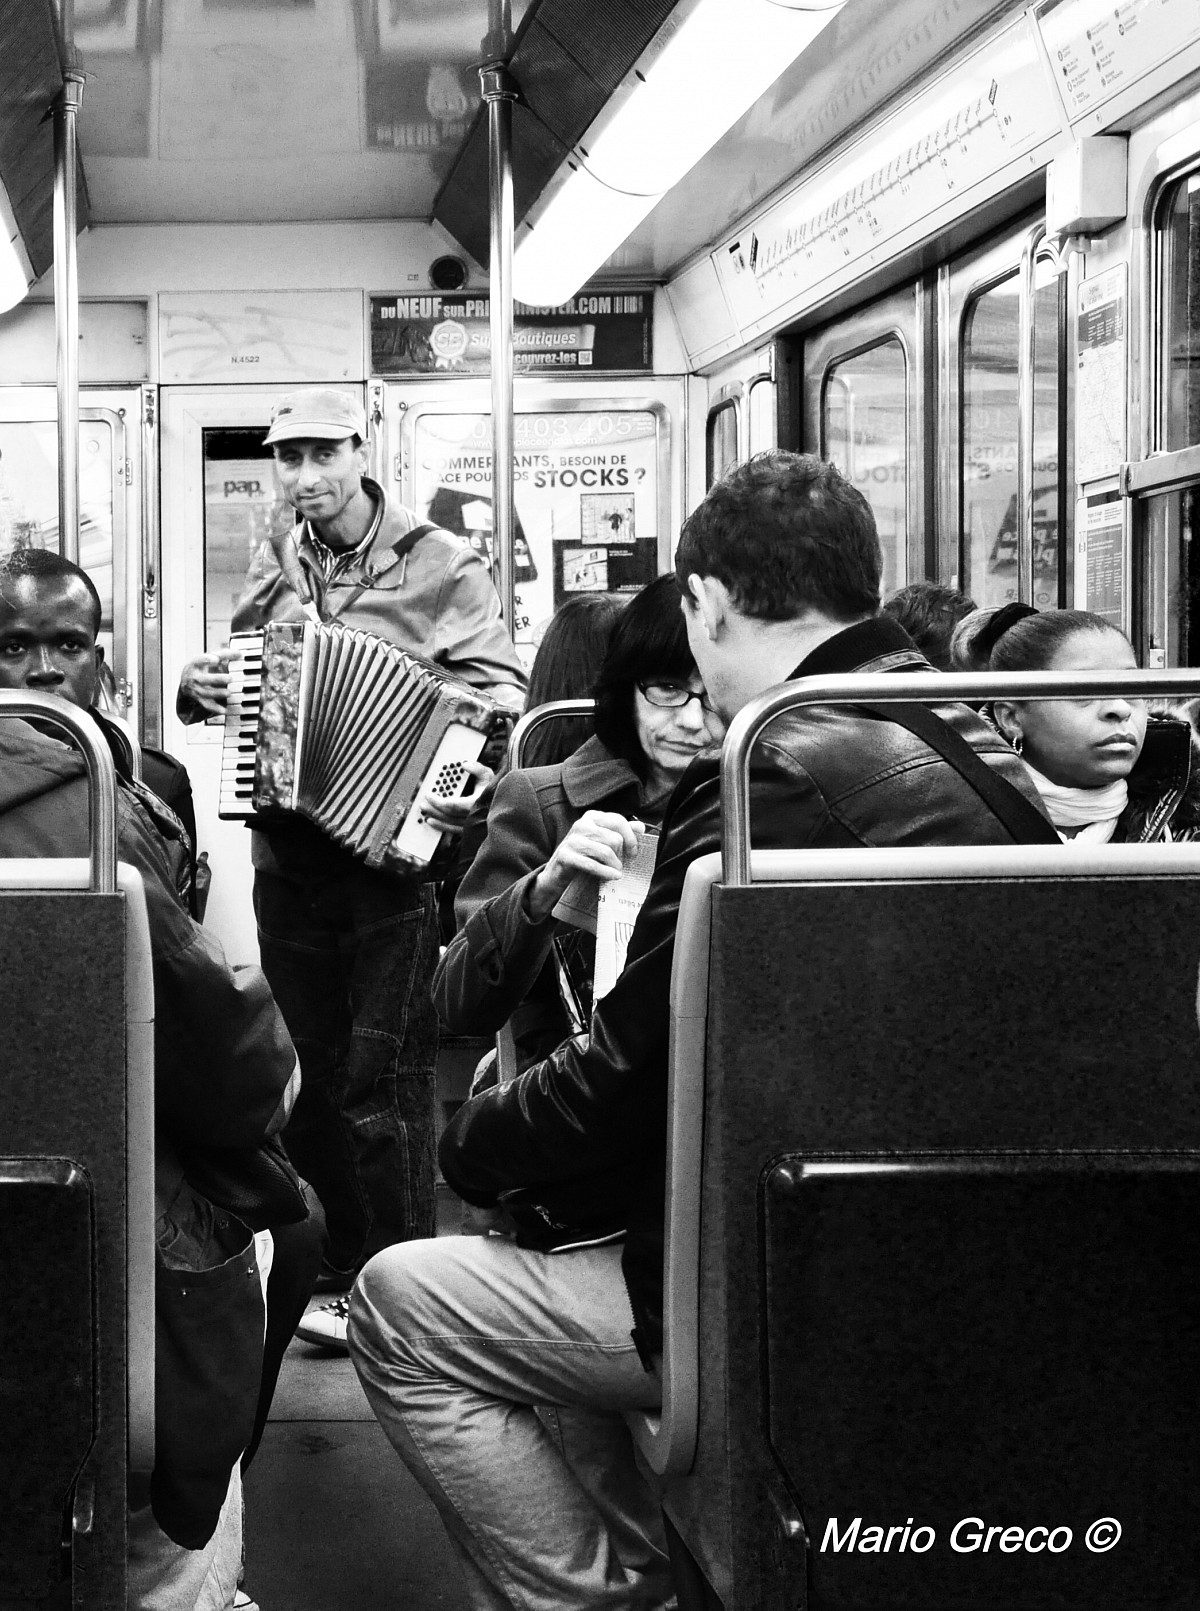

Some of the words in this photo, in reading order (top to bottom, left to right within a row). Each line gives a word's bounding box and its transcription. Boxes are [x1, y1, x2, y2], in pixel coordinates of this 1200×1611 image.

[381, 307, 395, 318] DU
[397, 298, 442, 318] NEUF
[444, 305, 464, 317] SUR
[514, 351, 577, 364] couvrez-les
[560, 456, 605, 466] BESOIN
[611, 455, 626, 465] DE
[465, 472, 491, 482] POU
[513, 471, 528, 481] OS
[534, 468, 629, 488] STOCKS
